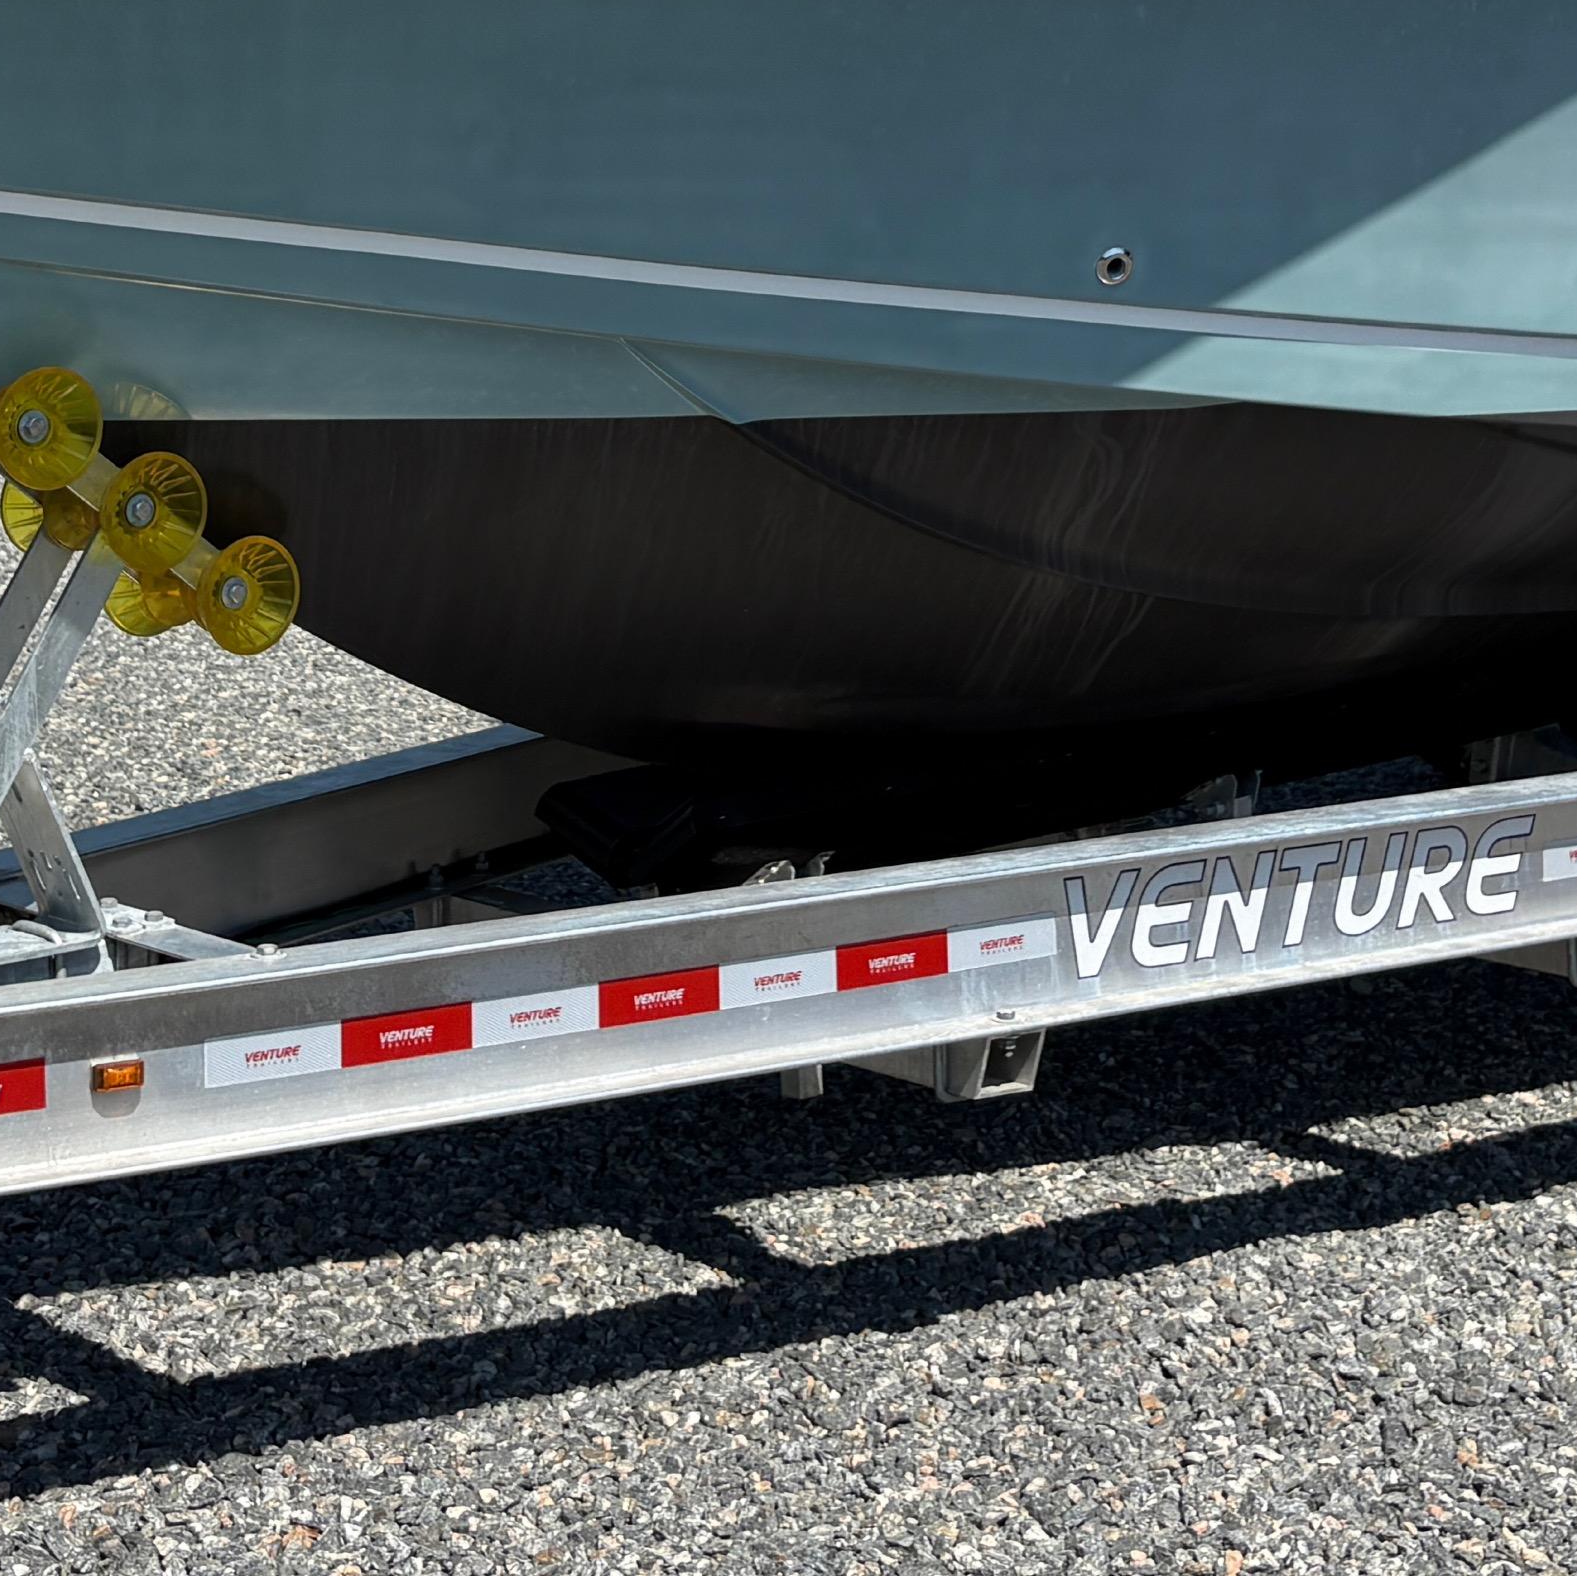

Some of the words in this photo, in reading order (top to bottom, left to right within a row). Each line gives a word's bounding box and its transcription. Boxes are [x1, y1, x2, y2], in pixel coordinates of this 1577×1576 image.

[1063, 814, 1537, 980] VENTURE
[980, 934, 1025, 950] VENTURE
[868, 952, 916, 969] VENTURE
[753, 970, 802, 986] VENTURE
[634, 988, 686, 1006] VENTURE
[509, 1006, 562, 1023] VENTURE
[379, 1025, 435, 1044] VENTURE
[244, 1045, 302, 1064] VENTURE
